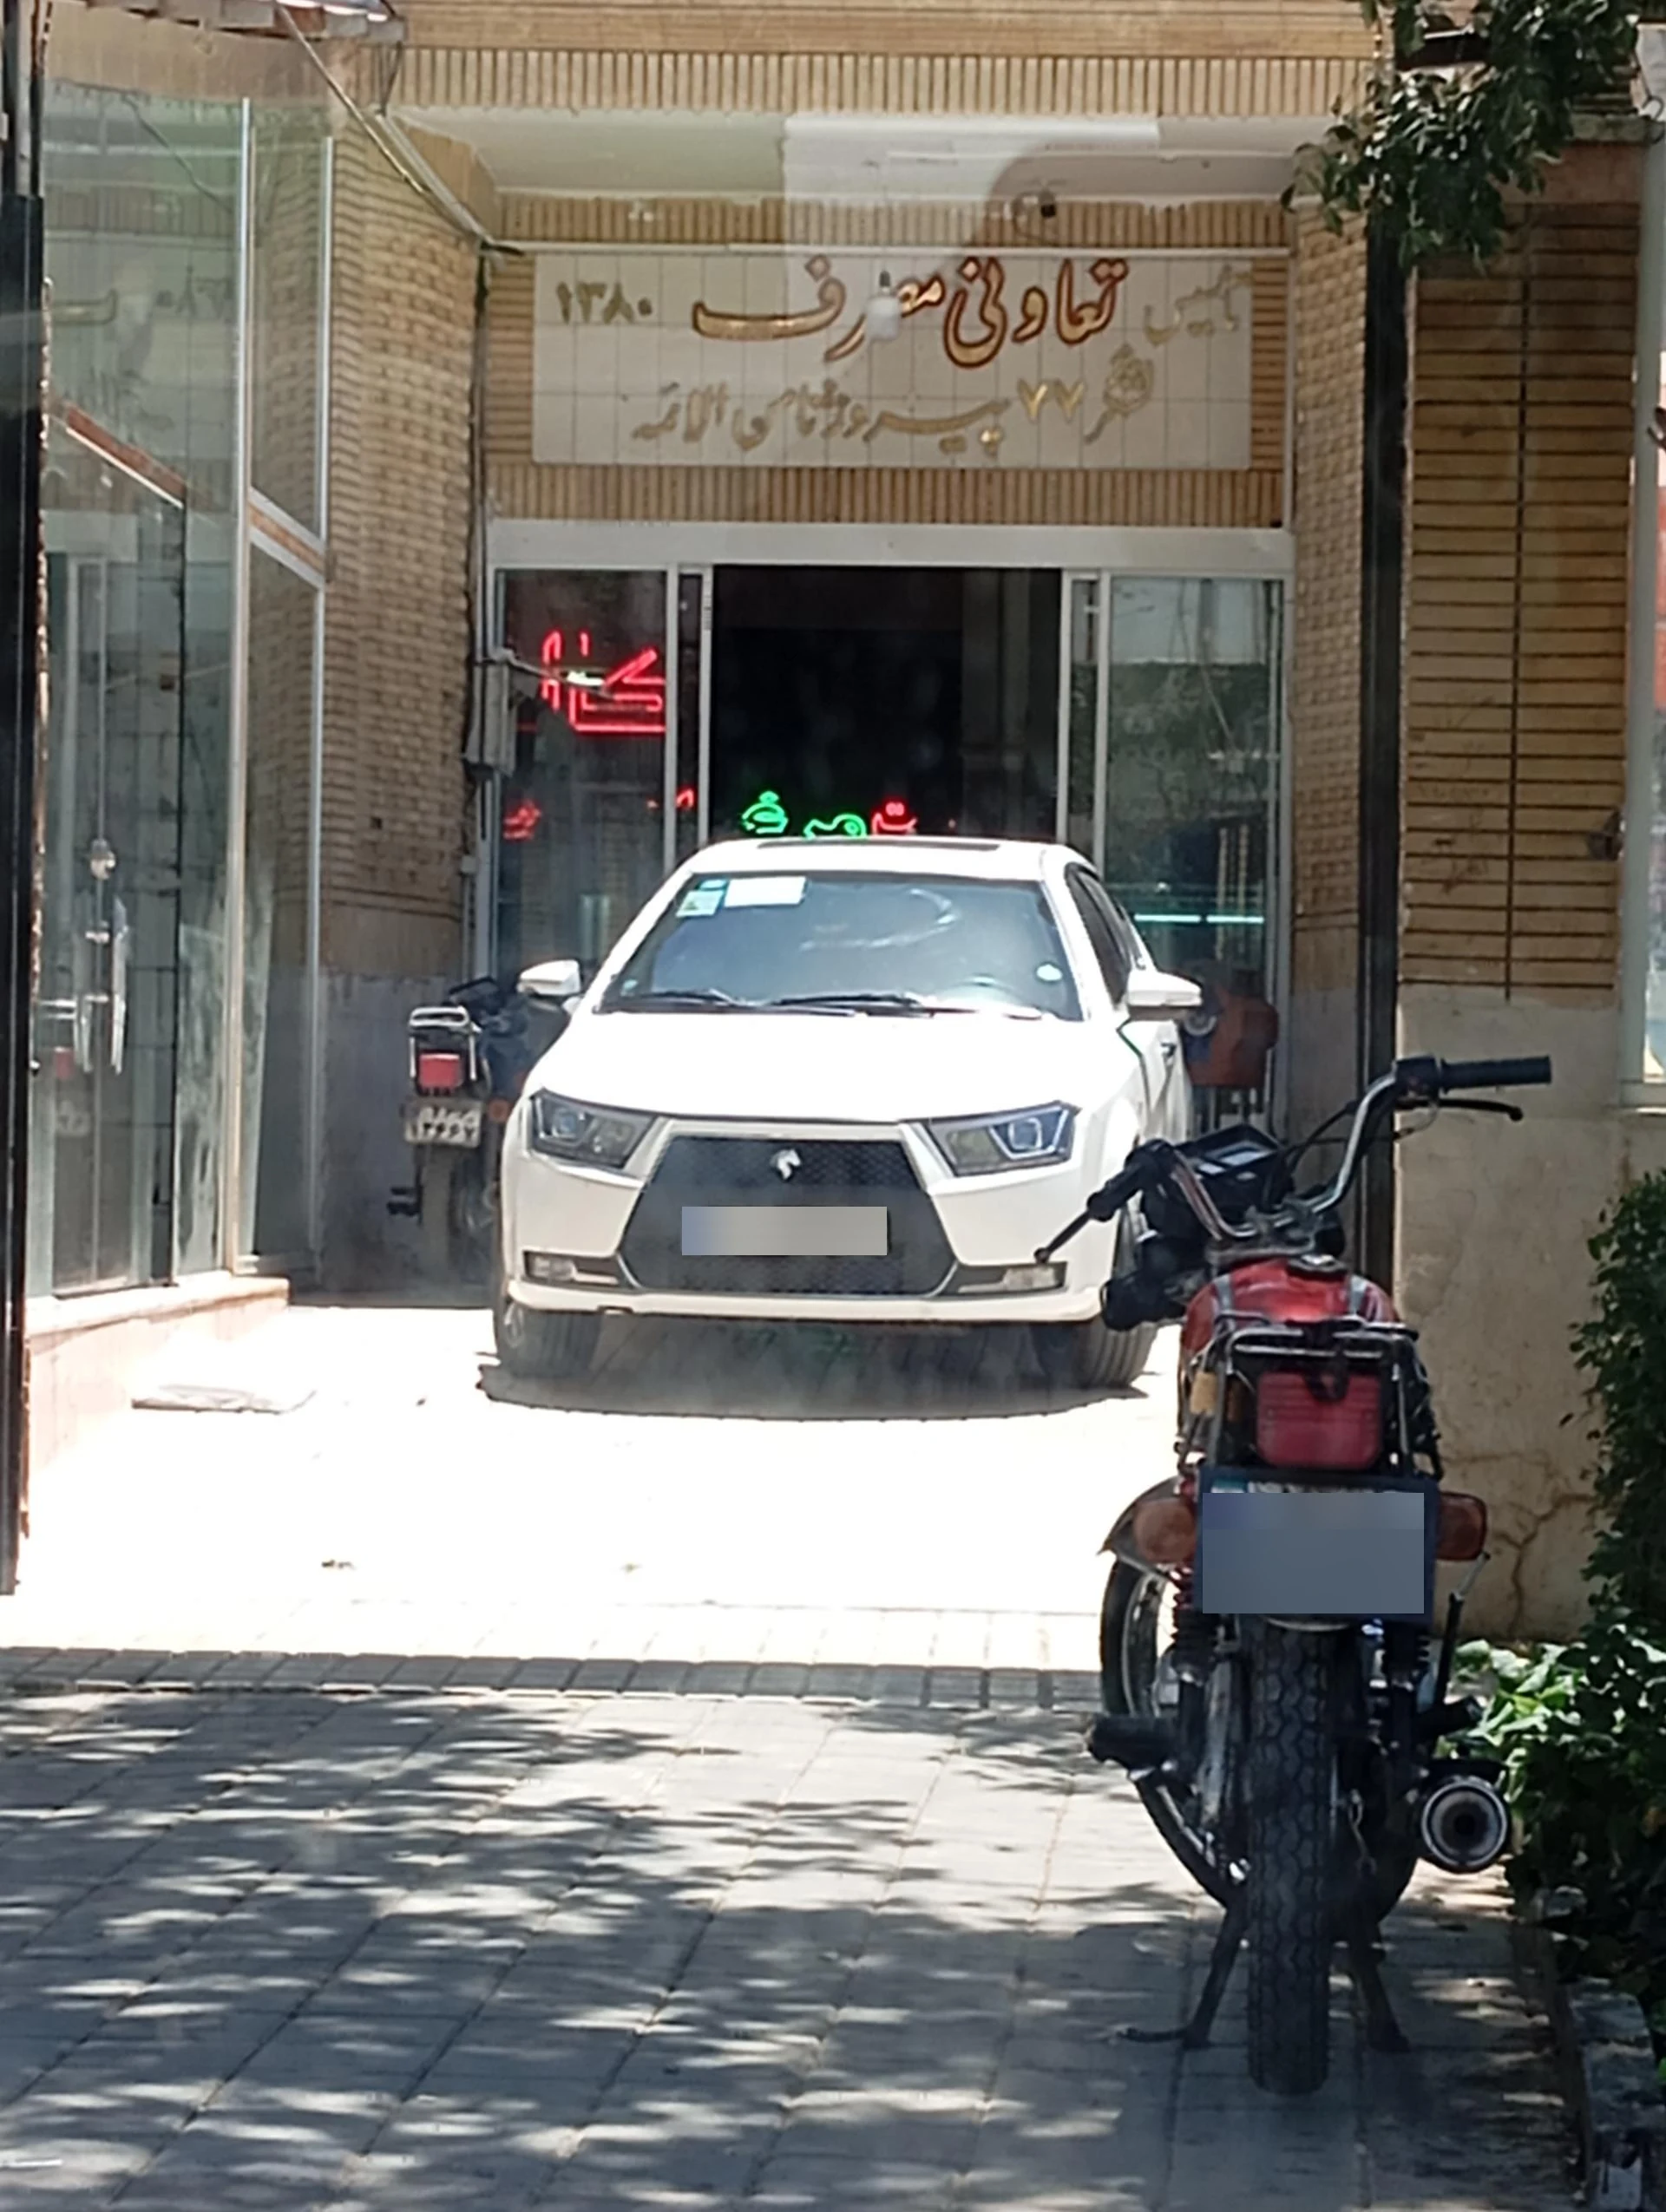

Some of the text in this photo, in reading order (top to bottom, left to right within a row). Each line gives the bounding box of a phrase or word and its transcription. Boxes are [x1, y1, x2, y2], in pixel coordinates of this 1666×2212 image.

[555, 279, 653, 324] ۱۳۸۰
[942, 255, 1131, 370] تعاونی
[1017, 377, 1087, 425] ۷۷
